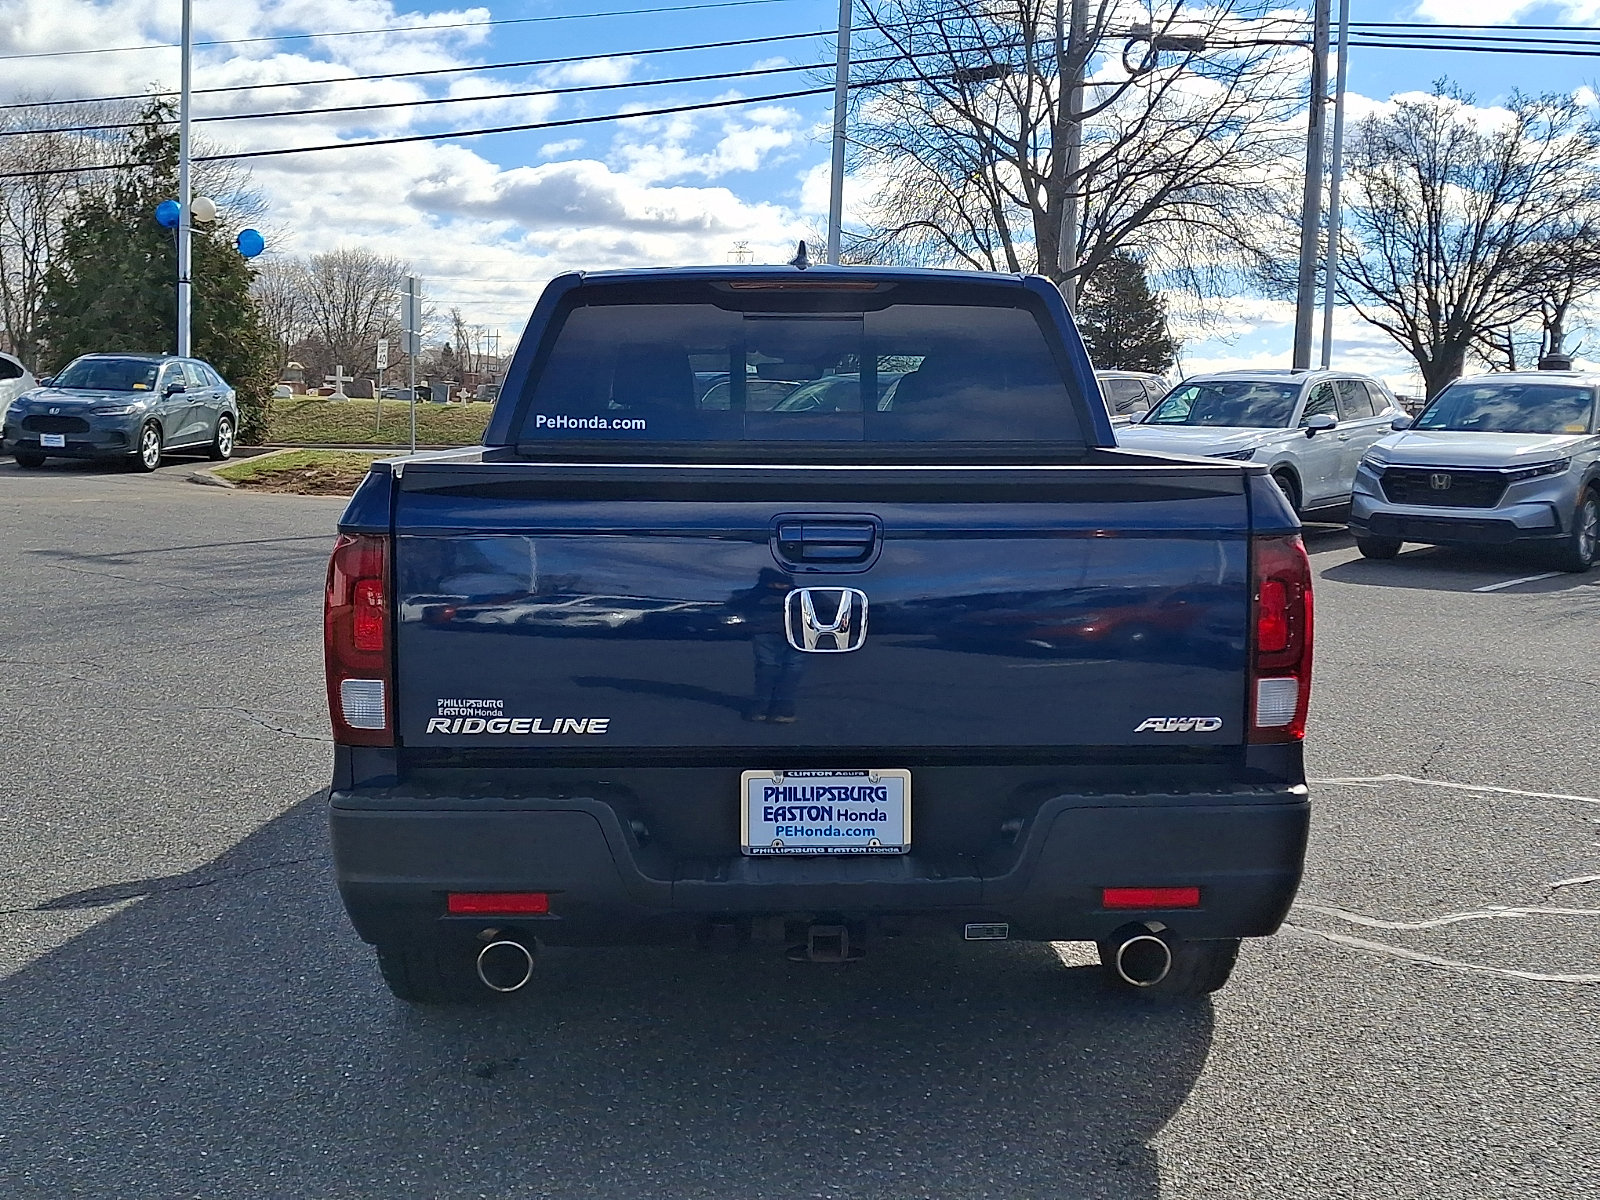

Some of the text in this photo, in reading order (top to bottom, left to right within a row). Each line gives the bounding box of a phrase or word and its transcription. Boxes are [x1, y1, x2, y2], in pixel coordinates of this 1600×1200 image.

[536, 414, 646, 430] PeHonda.com
[437, 699, 504, 709] PHILLIPSBURG
[438, 707, 503, 717] EASTON Honda
[425, 717, 611, 735] RIDGELINE
[1133, 717, 1223, 732] AWD
[763, 786, 888, 804] PHILLIPSBURG
[763, 805, 887, 824] EASTON Honda
[775, 825, 876, 837] PEHonda.com
[752, 846, 900, 855] PHILLIPSBURG EASTON Honda
